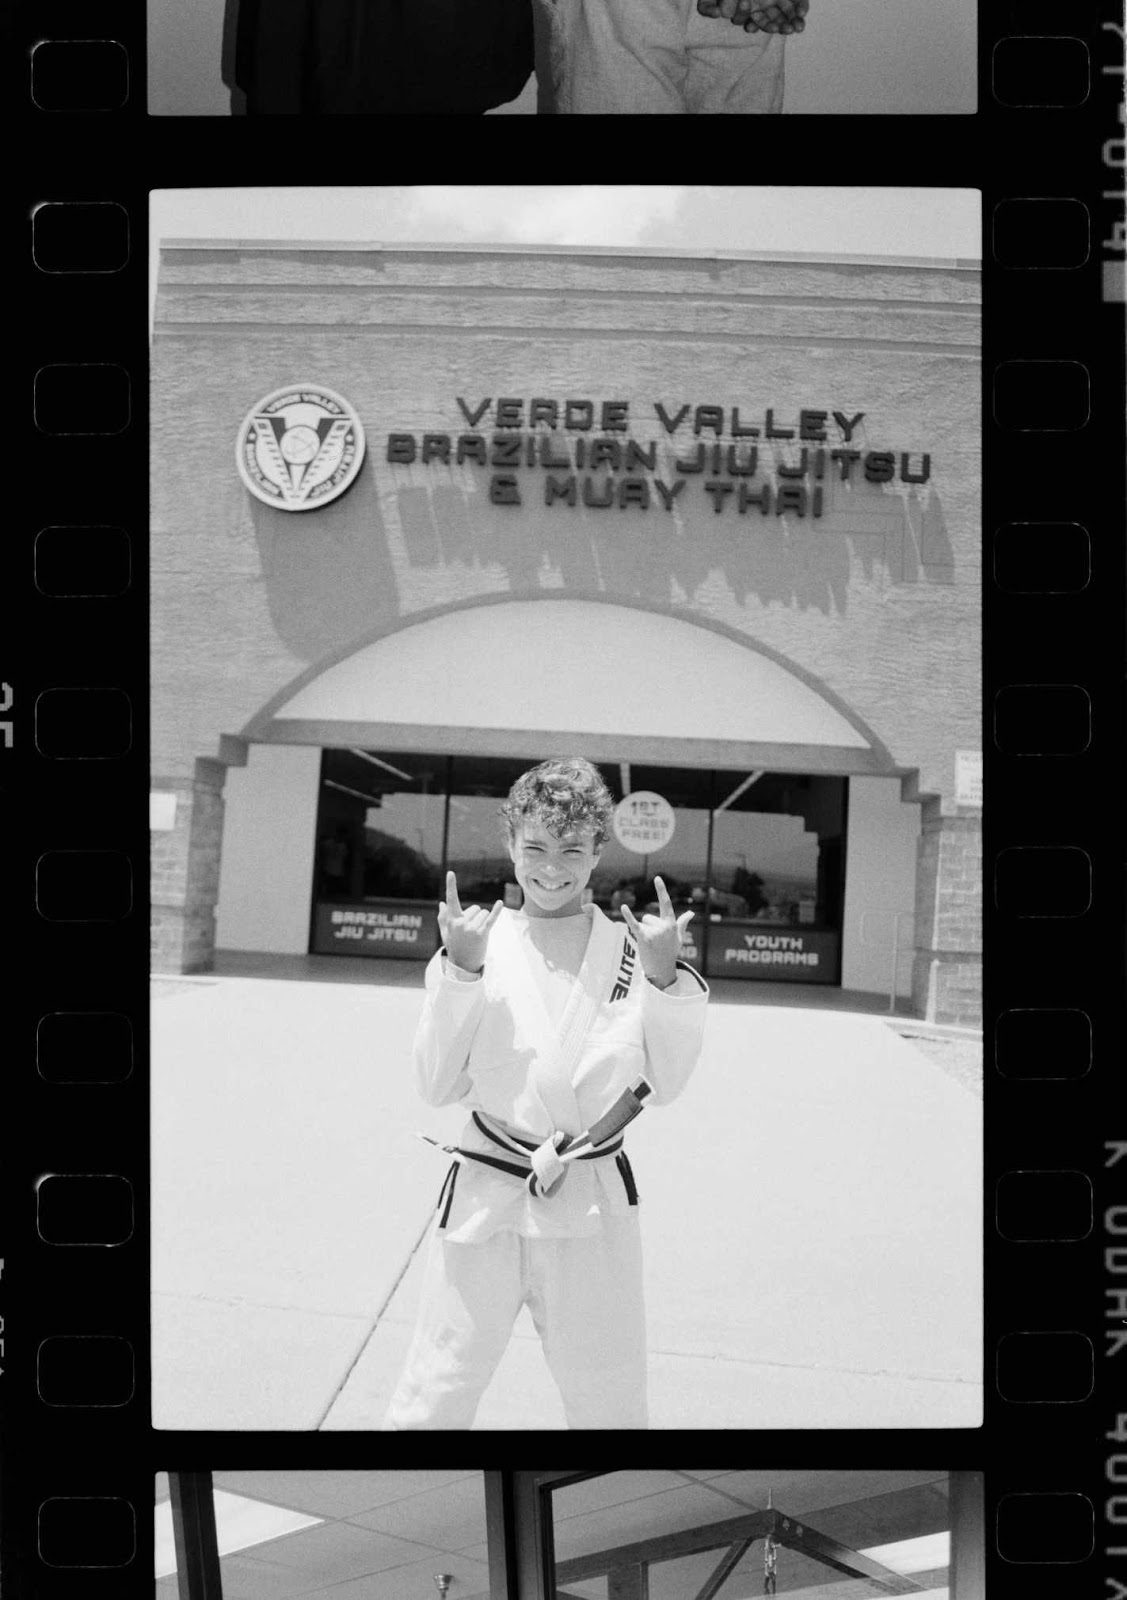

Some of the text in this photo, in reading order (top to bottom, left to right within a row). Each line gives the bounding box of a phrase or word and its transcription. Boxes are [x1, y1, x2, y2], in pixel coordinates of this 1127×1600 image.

[456, 397, 866, 441] VERDE VALLEY
[387, 433, 931, 483] BRAZILIAN JIU JITSU
[490, 474, 823, 518] & MUAY THAI
[620, 817, 669, 829] CLASS
[331, 911, 422, 927] BRAZILIAN
[334, 925, 418, 942] JIU JITSU
[745, 935, 803, 950] YOUTH
[725, 948, 819, 967] PROGRAMS
